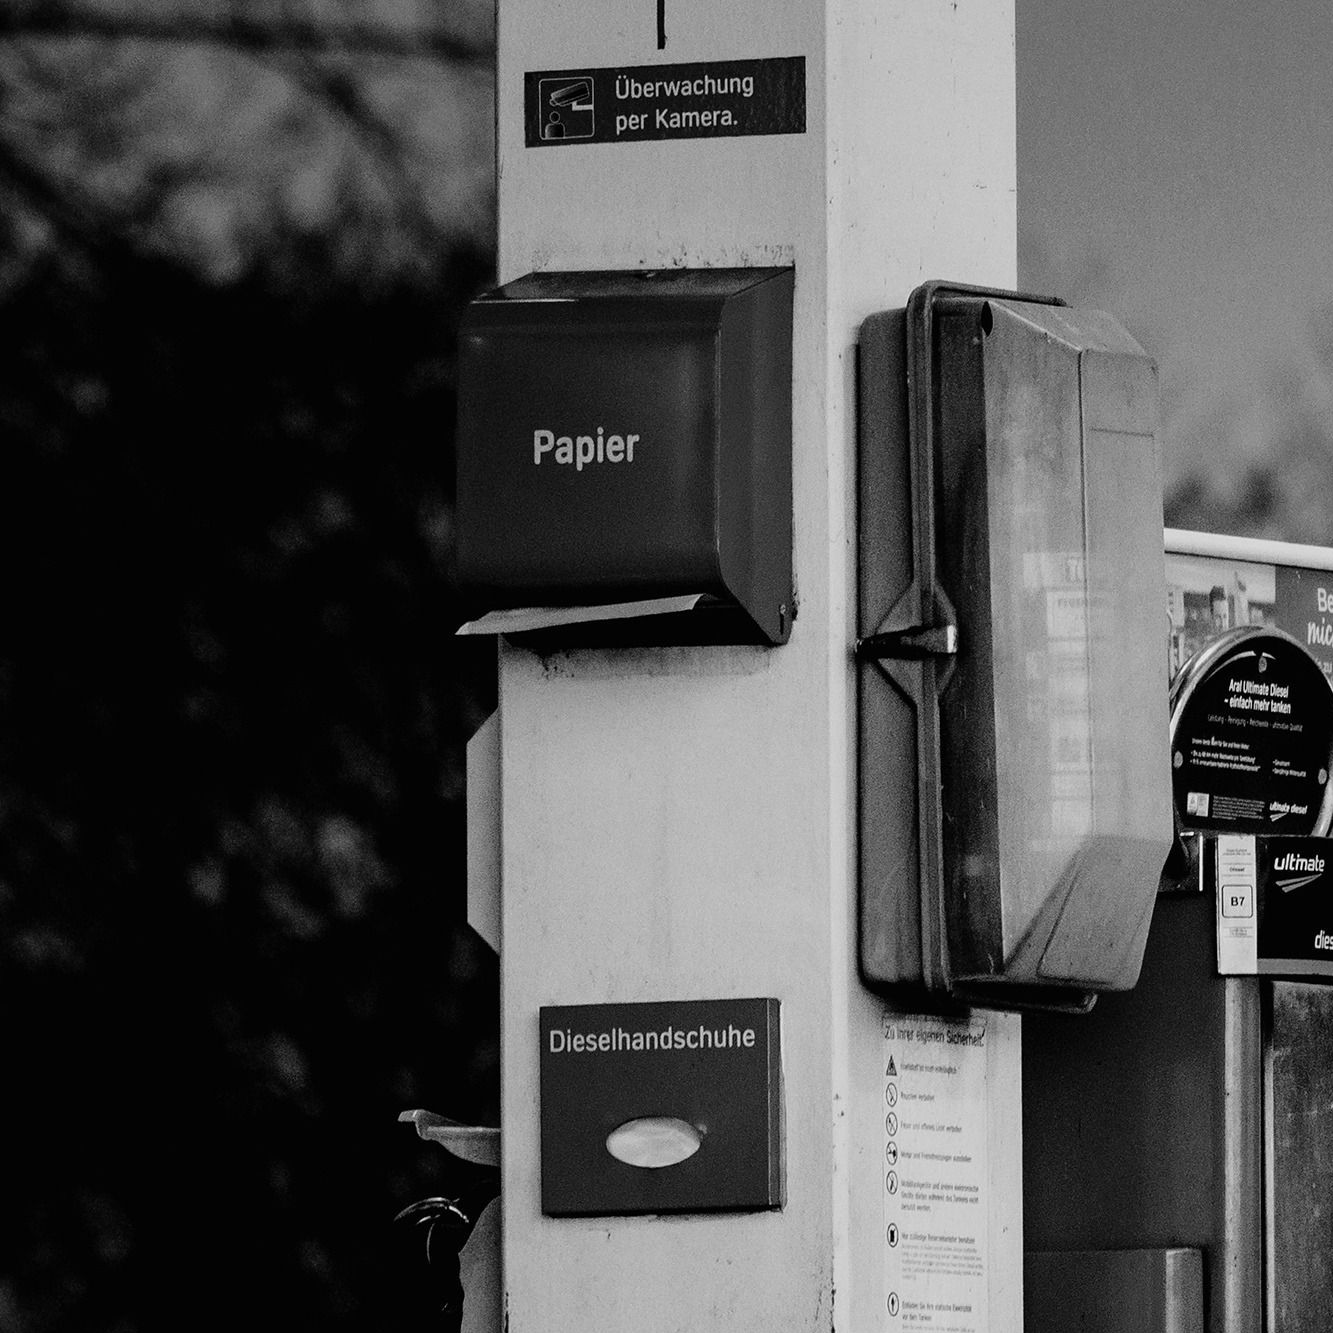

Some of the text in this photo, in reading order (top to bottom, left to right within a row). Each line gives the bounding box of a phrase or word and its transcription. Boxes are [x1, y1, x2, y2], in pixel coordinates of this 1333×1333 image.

[615, 74, 754, 100] Überwachung
[616, 108, 738, 135] per Kamera.
[534, 426, 640, 471] Papier
[1229, 679, 1288, 698] Aral Ultimate Diesel
[1230, 696, 1290, 714] einfach mehr tanken
[1274, 853, 1325, 872] ultimate
[1231, 896, 1246, 906] B7
[550, 1024, 756, 1053] Dieselhandschuhe
[917, 1030, 944, 1045] eigenen
